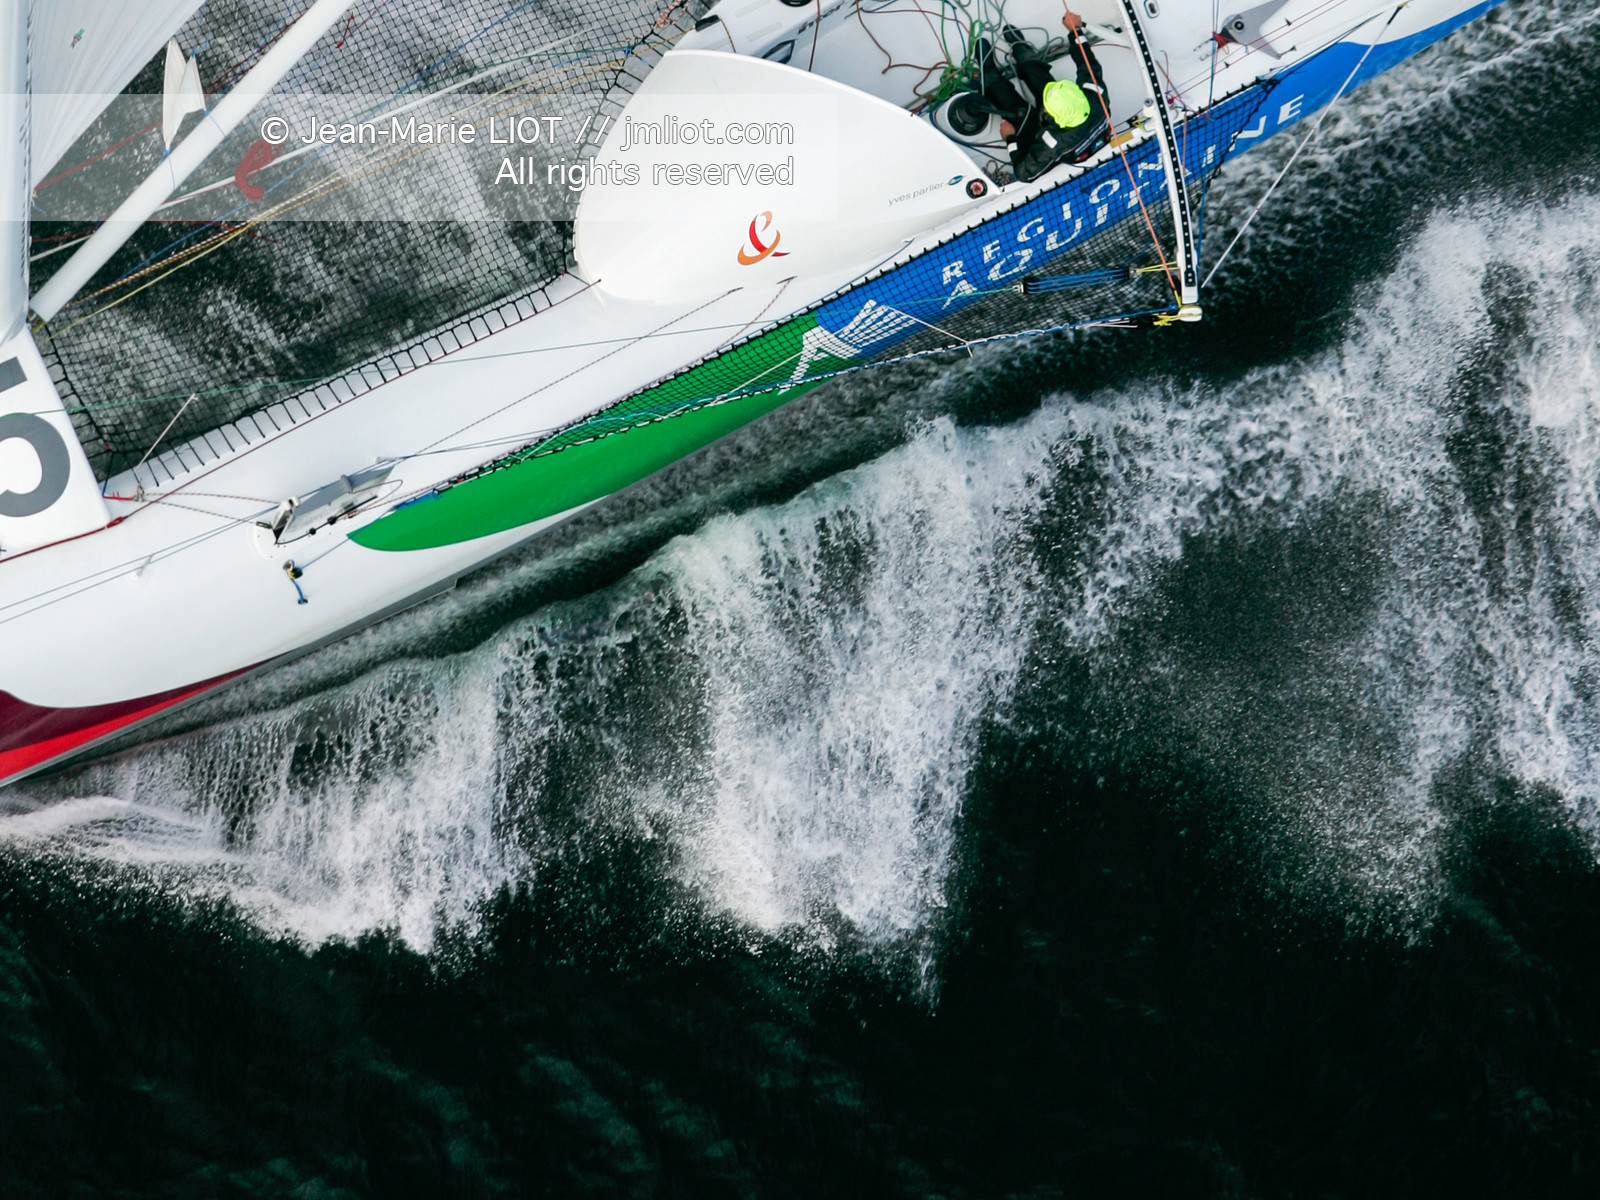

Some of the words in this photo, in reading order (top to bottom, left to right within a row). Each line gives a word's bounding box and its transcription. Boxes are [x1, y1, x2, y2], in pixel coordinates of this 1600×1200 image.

[888, 191, 911, 206] yves
[912, 181, 945, 199] parlier
[942, 152, 1165, 285] REGION
